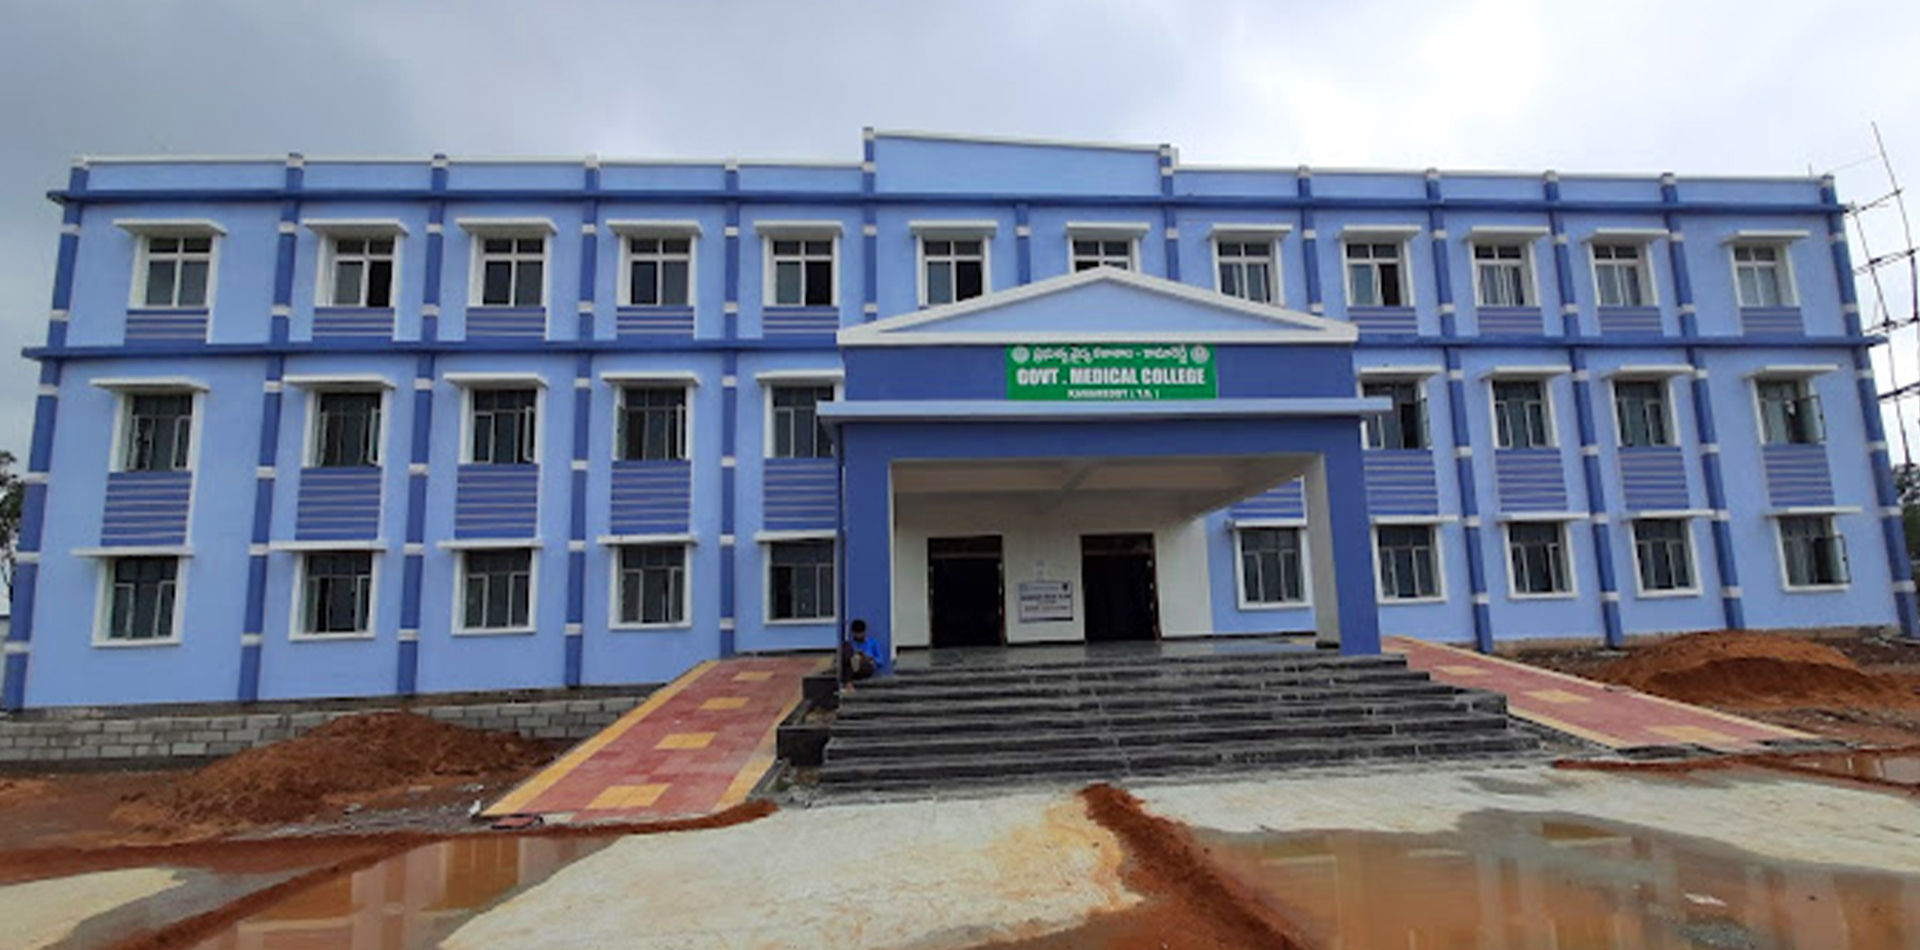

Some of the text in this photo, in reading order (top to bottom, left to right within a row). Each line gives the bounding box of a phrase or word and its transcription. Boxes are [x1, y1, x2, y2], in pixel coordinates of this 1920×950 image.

[1017, 368, 1058, 385] GOVT
[1070, 368, 1138, 385] MEDICAL
[1141, 367, 1205, 385] COLLEGE
